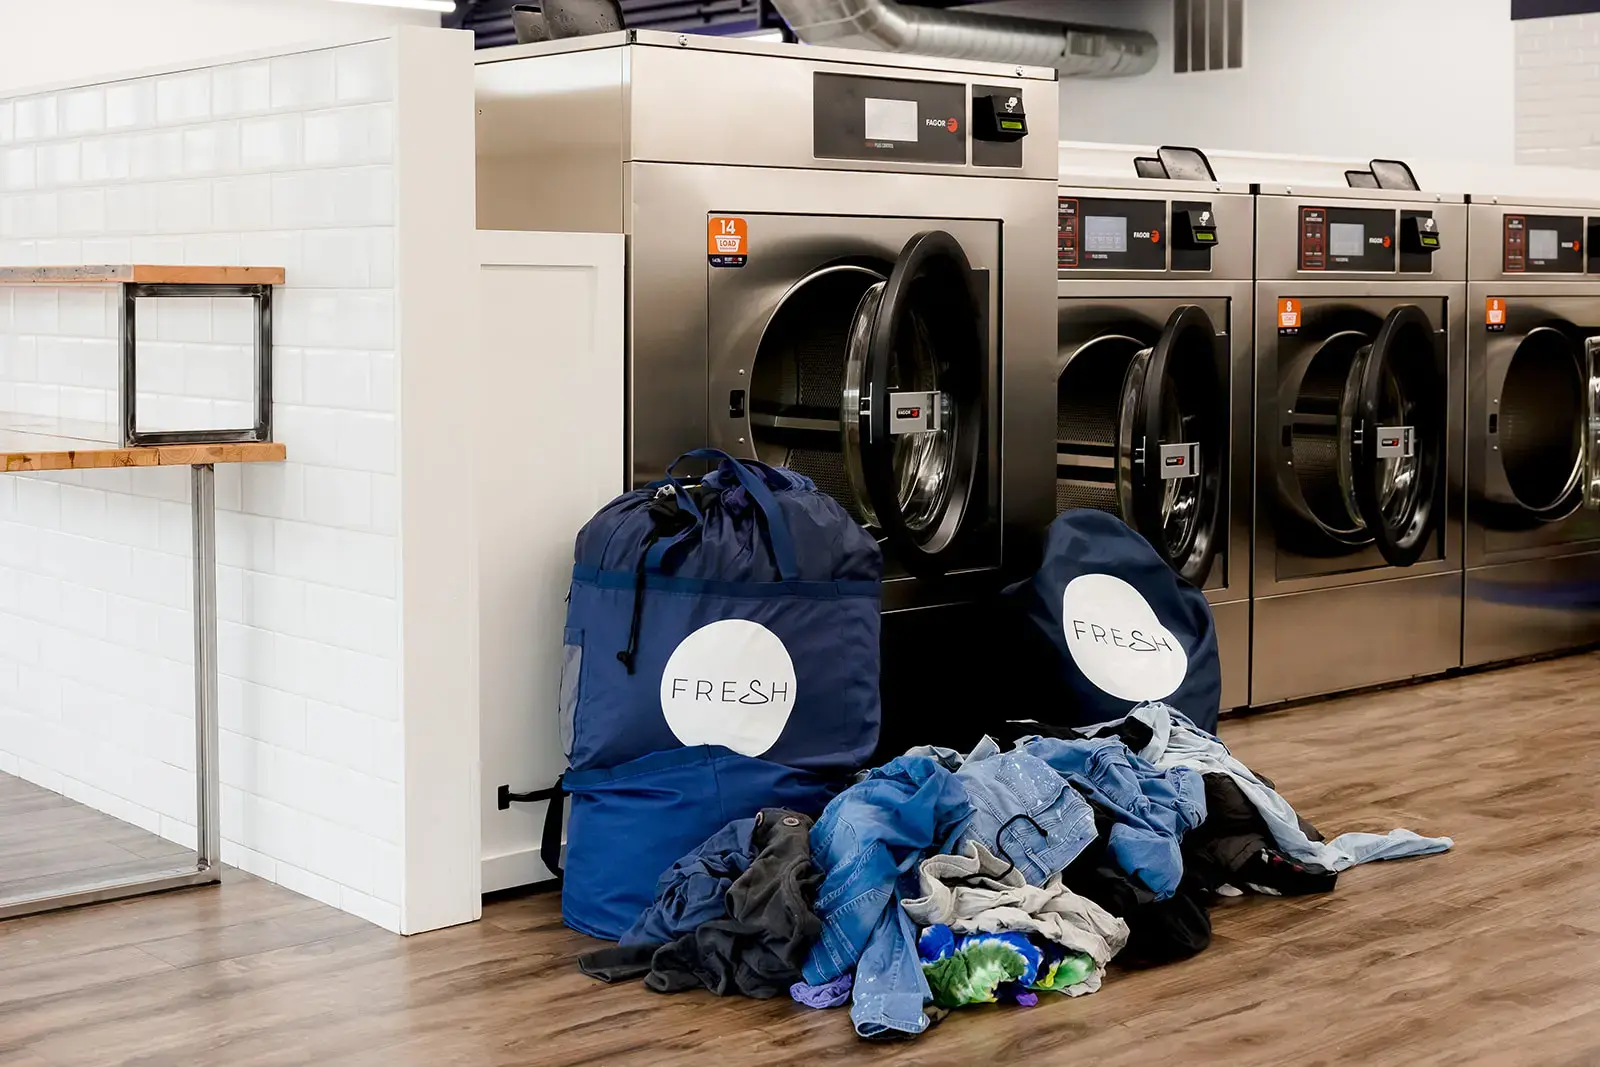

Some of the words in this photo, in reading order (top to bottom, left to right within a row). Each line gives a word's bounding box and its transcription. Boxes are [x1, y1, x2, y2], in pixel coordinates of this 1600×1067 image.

[925, 119, 946, 127] FAGOR
[720, 219, 736, 234] 14
[1286, 300, 1293, 312] 8
[1073, 619, 1173, 652] FRESH
[671, 678, 788, 705] FRESH
